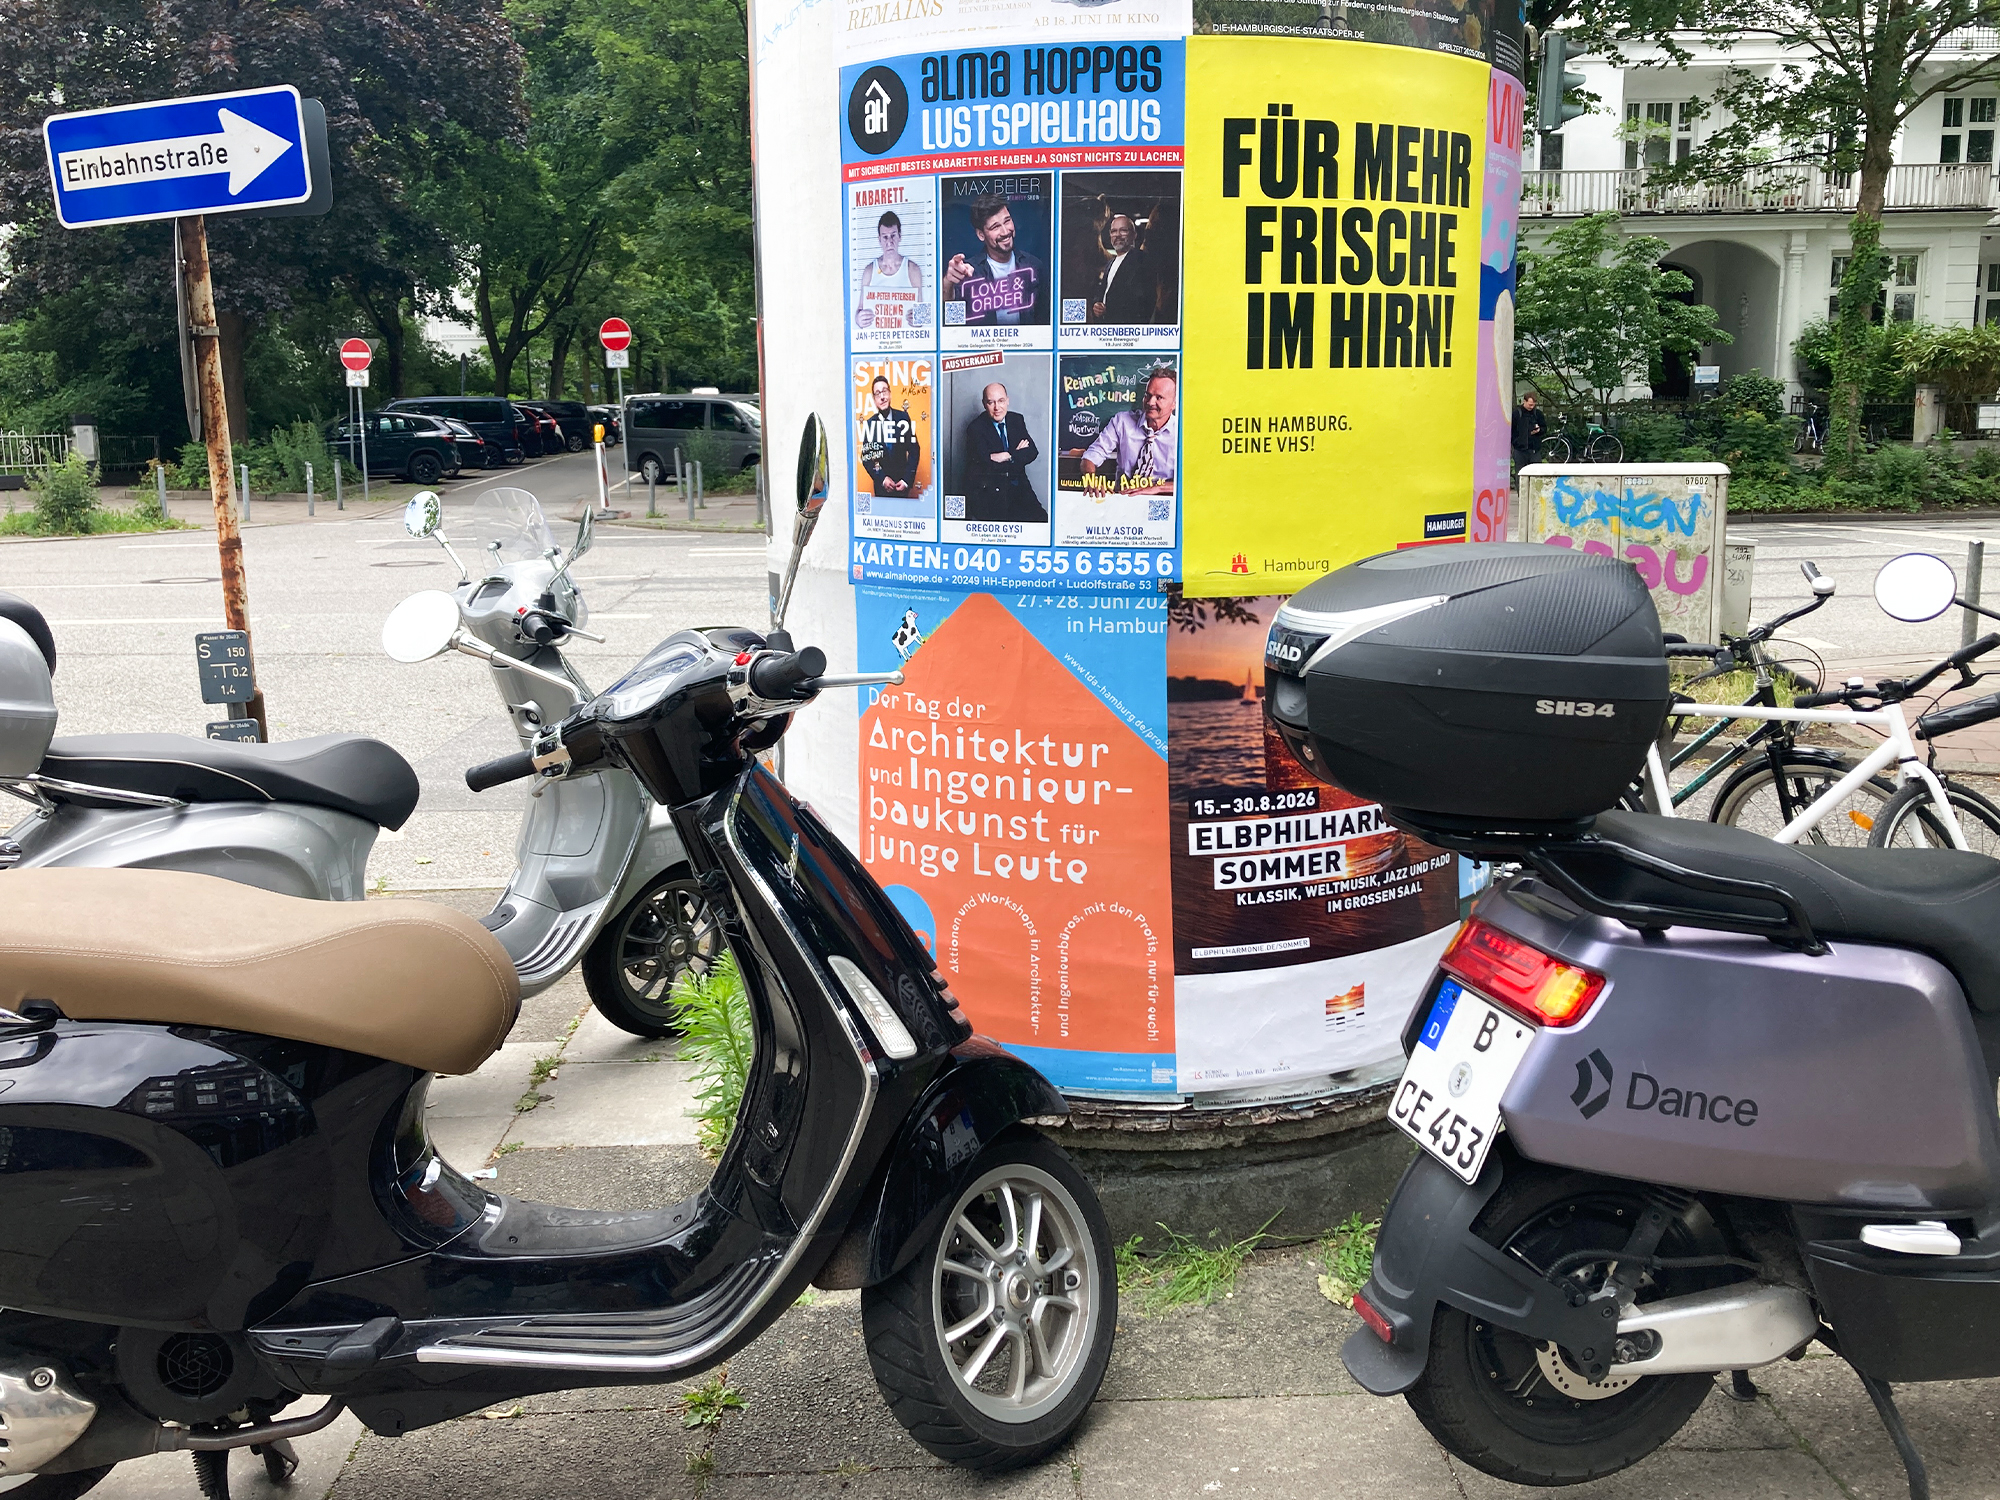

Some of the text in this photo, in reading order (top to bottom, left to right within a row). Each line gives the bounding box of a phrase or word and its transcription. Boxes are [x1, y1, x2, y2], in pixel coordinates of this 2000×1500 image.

[846, 0, 943, 31] REMAINS
[958, 6, 989, 14] HLYNUR
[1034, 13, 1160, 27] AB 18. JUNI IM KINO
[1377, 3, 1387, 11] der
[1388, 4, 1432, 18] Hamburgischen
[1433, 12, 1460, 24] Staatsoper
[1212, 23, 1365, 40] DIE-HAMBURGISCHE-STAATSOPER.DE
[1439, 42, 1463, 53] SPIELZEIT
[65, 142, 229, 183] Einbahnstraße
[849, 150, 1183, 178] MIT SICHERHEIT BESTES KABARETT! SIE HABEN JA SONST NICHTS ZU LACHEN.
[1222, 103, 1472, 209] FÜR MEHR
[855, 186, 909, 207] KABARETT.
[954, 178, 1040, 196] MAX BEIER
[1245, 205, 1457, 288] FRISCHE
[971, 277, 1025, 299] LOVE &
[972, 292, 1022, 312] ORDER
[856, 330, 930, 341] JAN-PETER PETERSEN
[971, 328, 1019, 338] MAX BEIER
[1060, 327, 1179, 337] LUTZ V. ROSENBERG LIPINSKY
[1246, 291, 1455, 370] IM HIRN!
[944, 354, 1000, 371] AUSVERKAUFT
[854, 360, 932, 387] STING
[1117, 374, 1137, 386] und
[856, 391, 878, 416] JA
[856, 420, 917, 443] WIE?!
[1222, 415, 1353, 434] DEIN HAMBURG.
[1222, 436, 1315, 454] DEINE VHS!
[1685, 476, 1709, 485] 67602
[863, 518, 926, 530] KAI MAGNUS STING
[966, 523, 1023, 533] GREGOR GYSI
[1086, 526, 1144, 536] WILLY ASTOR
[1426, 518, 1466, 532] HAMBURGER
[853, 541, 1174, 576] KARTEN: 040 555 6 555 6
[1264, 558, 1330, 573] Hamburg
[866, 570, 1152, 590] www.almahoppe.de 20249 HH-Eppendorf Ludolfstraße 53
[1067, 616, 1168, 634] in Hambur
[199, 643, 246, 659] S 150
[1266, 640, 1302, 662] SHAD
[232, 667, 248, 677] 0.2
[221, 685, 236, 695] 1.4
[868, 686, 986, 719] Der Tag der
[1535, 699, 1616, 718] SH34
[868, 716, 1109, 768] Architektur
[869, 757, 1133, 805] und Ingenieur-
[869, 785, 1100, 845] baukunst für
[865, 824, 1088, 885] junge Leute
[1219, 850, 1341, 885] SOMMER
[1236, 852, 1451, 906] KLASSIK, WELTMUSIK, JAZZ UND FADO
[1327, 881, 1423, 913] IM GROSSEN SAAL
[1194, 939, 1308, 957] ELBPHILHARMONIE.DE/SOMMER
[949, 892, 1042, 1036] Aktionen und Workshops in Architektur-
[1057, 902, 1160, 1042] und Ingenieurbüros, mit den Profis, nur für euch!
[1428, 1022, 1440, 1040] D
[1473, 1010, 1500, 1053] B
[1626, 1070, 1760, 1127] Dance
[1395, 1080, 1434, 1134] CE
[1428, 1107, 1485, 1170] 453
